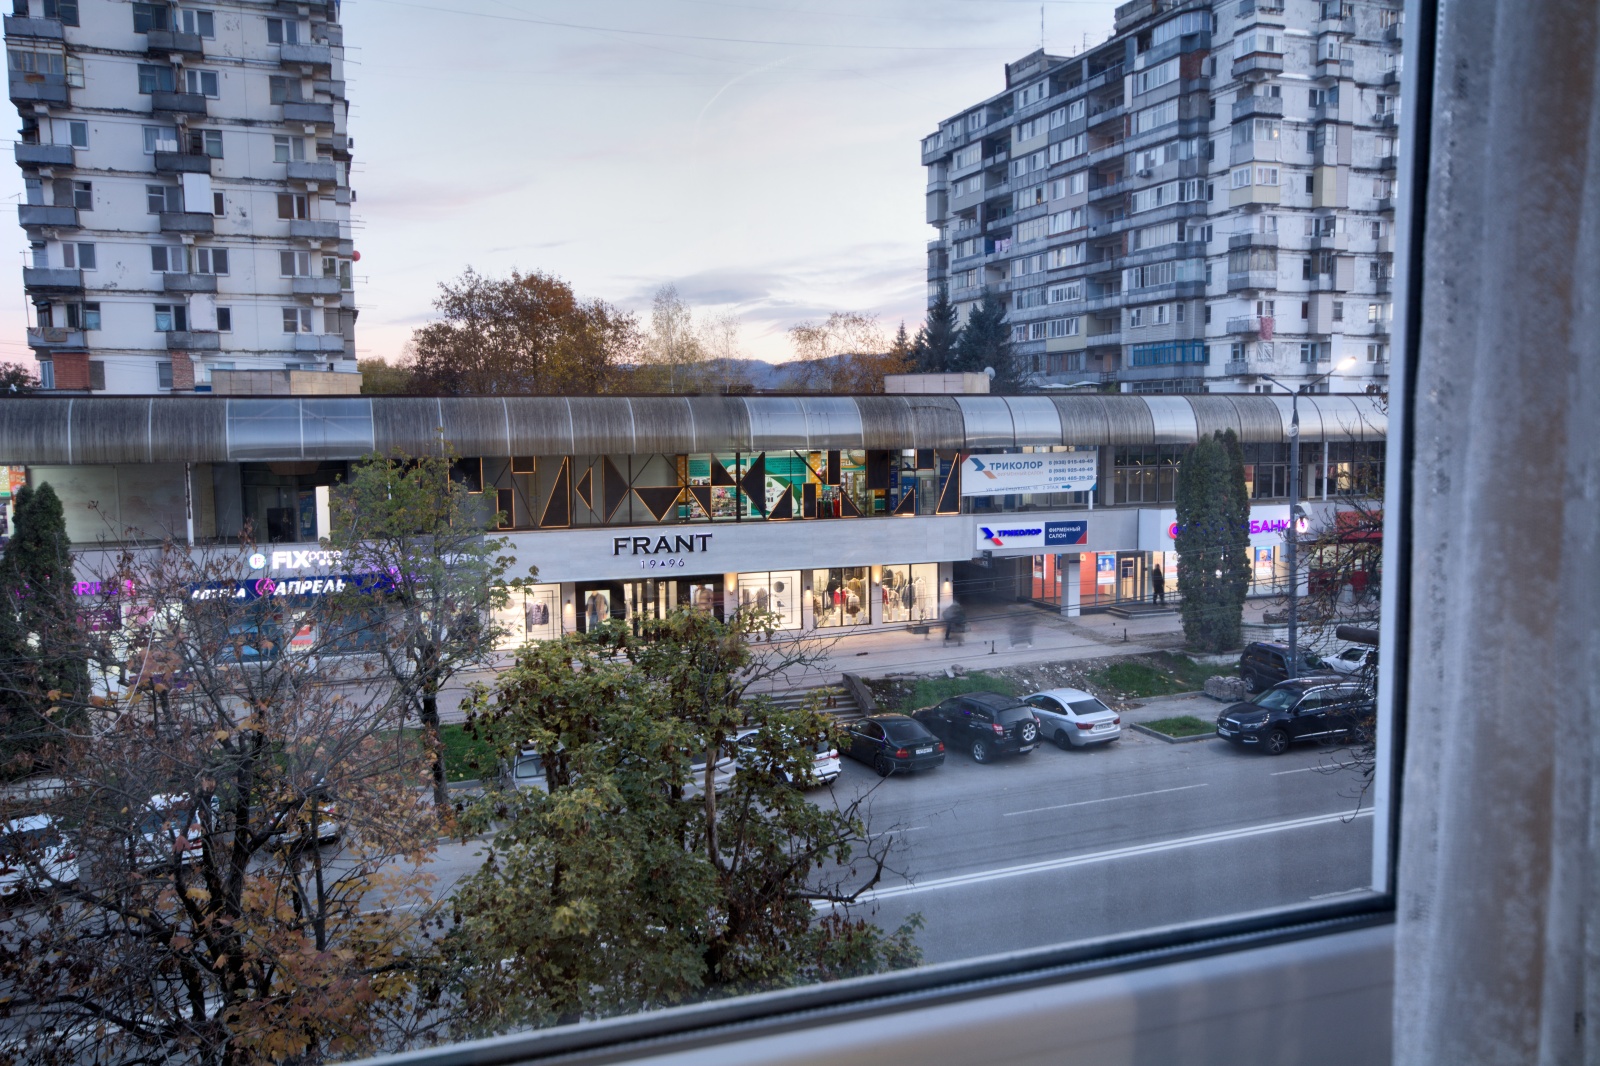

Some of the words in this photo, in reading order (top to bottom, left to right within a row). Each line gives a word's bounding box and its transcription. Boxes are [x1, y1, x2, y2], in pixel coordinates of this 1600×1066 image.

[989, 461, 1043, 471] ТРИКОЛОР
[997, 528, 1042, 537] ТРИКОЛОР
[1048, 525, 1081, 533] ФИРМЕННЫЙ
[613, 532, 712, 556] FRANT
[272, 550, 310, 569] FIX
[308, 550, 342, 562] price
[273, 578, 346, 596] АПРЕЛЬ
